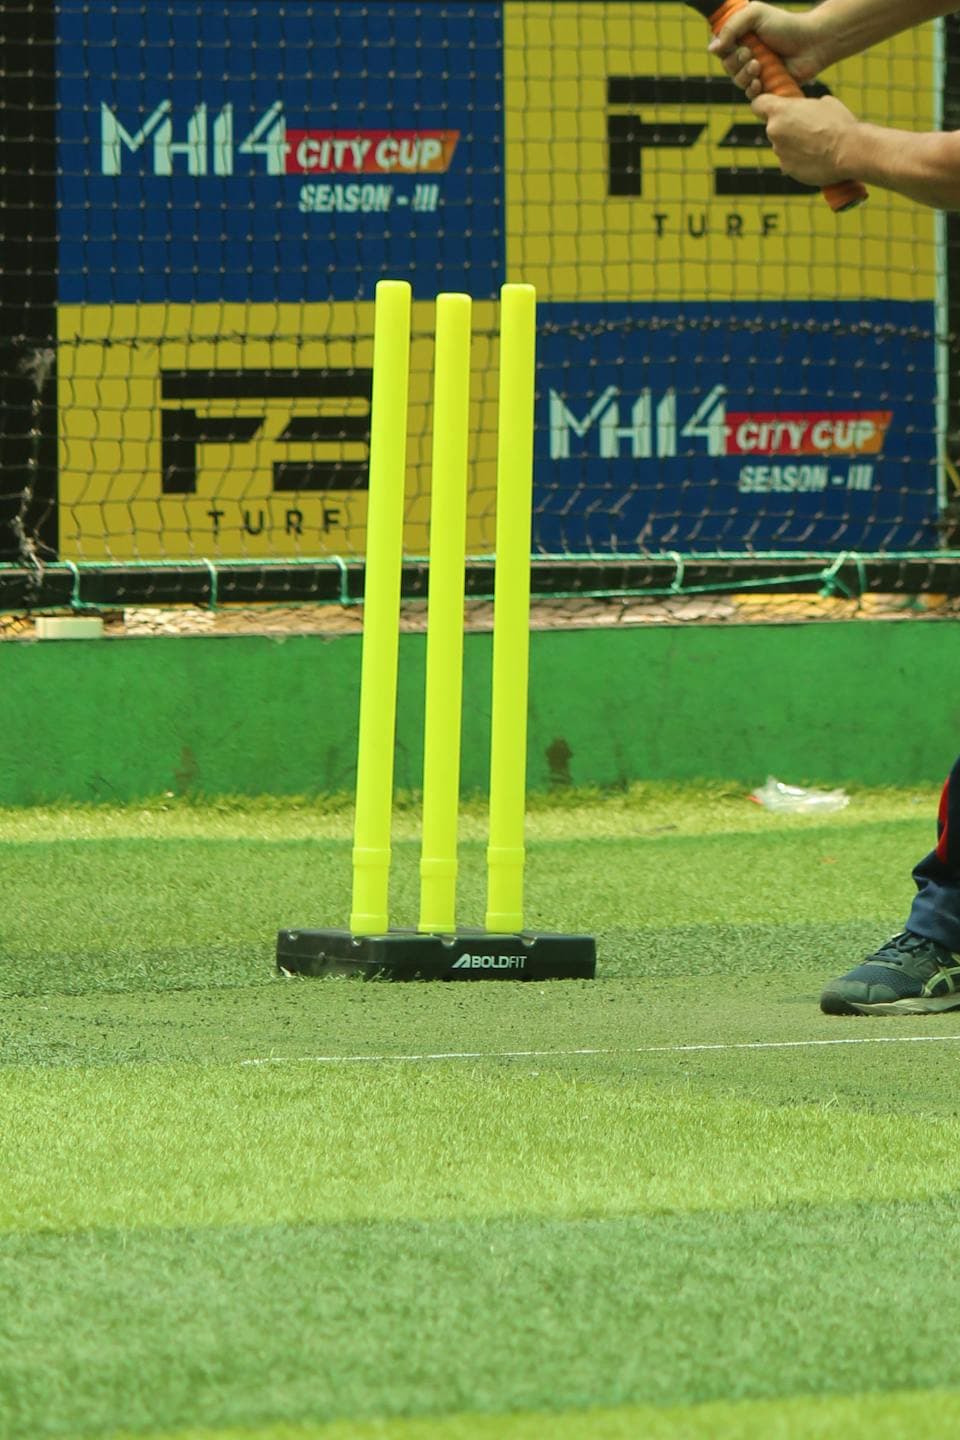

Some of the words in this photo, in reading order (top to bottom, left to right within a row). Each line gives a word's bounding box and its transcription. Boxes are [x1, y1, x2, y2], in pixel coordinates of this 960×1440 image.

[296, 139, 371, 168] CITY
[375, 139, 443, 168] CUP
[299, 184, 393, 212] SEASON
[413, 184, 439, 212] III
[654, 214, 778, 237] TURF
[736, 421, 808, 450] CITY
[811, 420, 875, 450] CUP
[738, 465, 829, 492] SEASON
[846, 465, 873, 491] III
[208, 511, 340, 536] TURF
[471, 955, 528, 969] BOLDFIT
